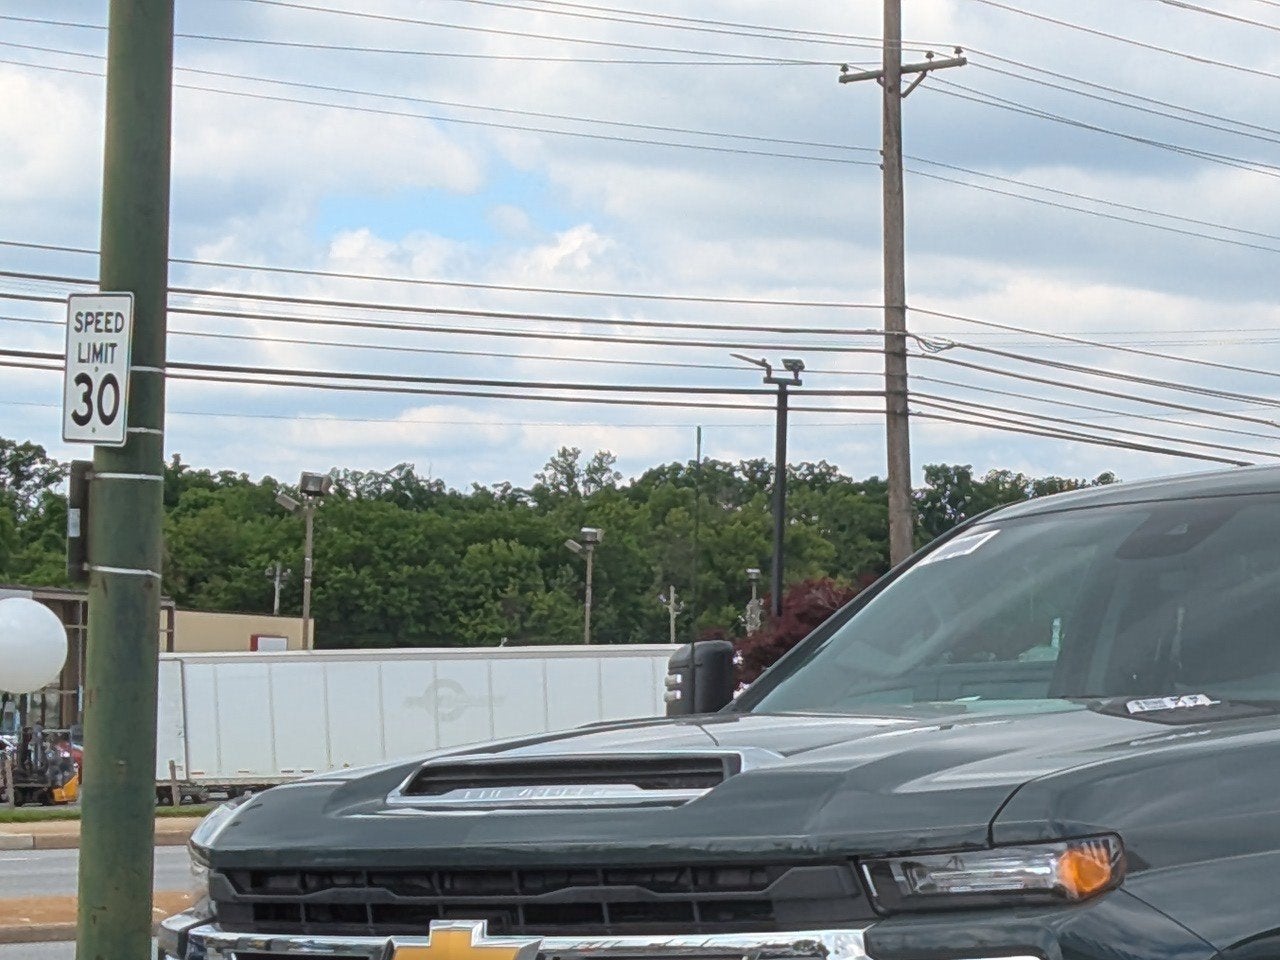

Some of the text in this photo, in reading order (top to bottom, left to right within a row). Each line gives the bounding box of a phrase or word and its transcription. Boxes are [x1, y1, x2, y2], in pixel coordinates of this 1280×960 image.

[73, 311, 124, 333] SPEED
[77, 342, 117, 363] LIMIT
[71, 372, 120, 426] 30
